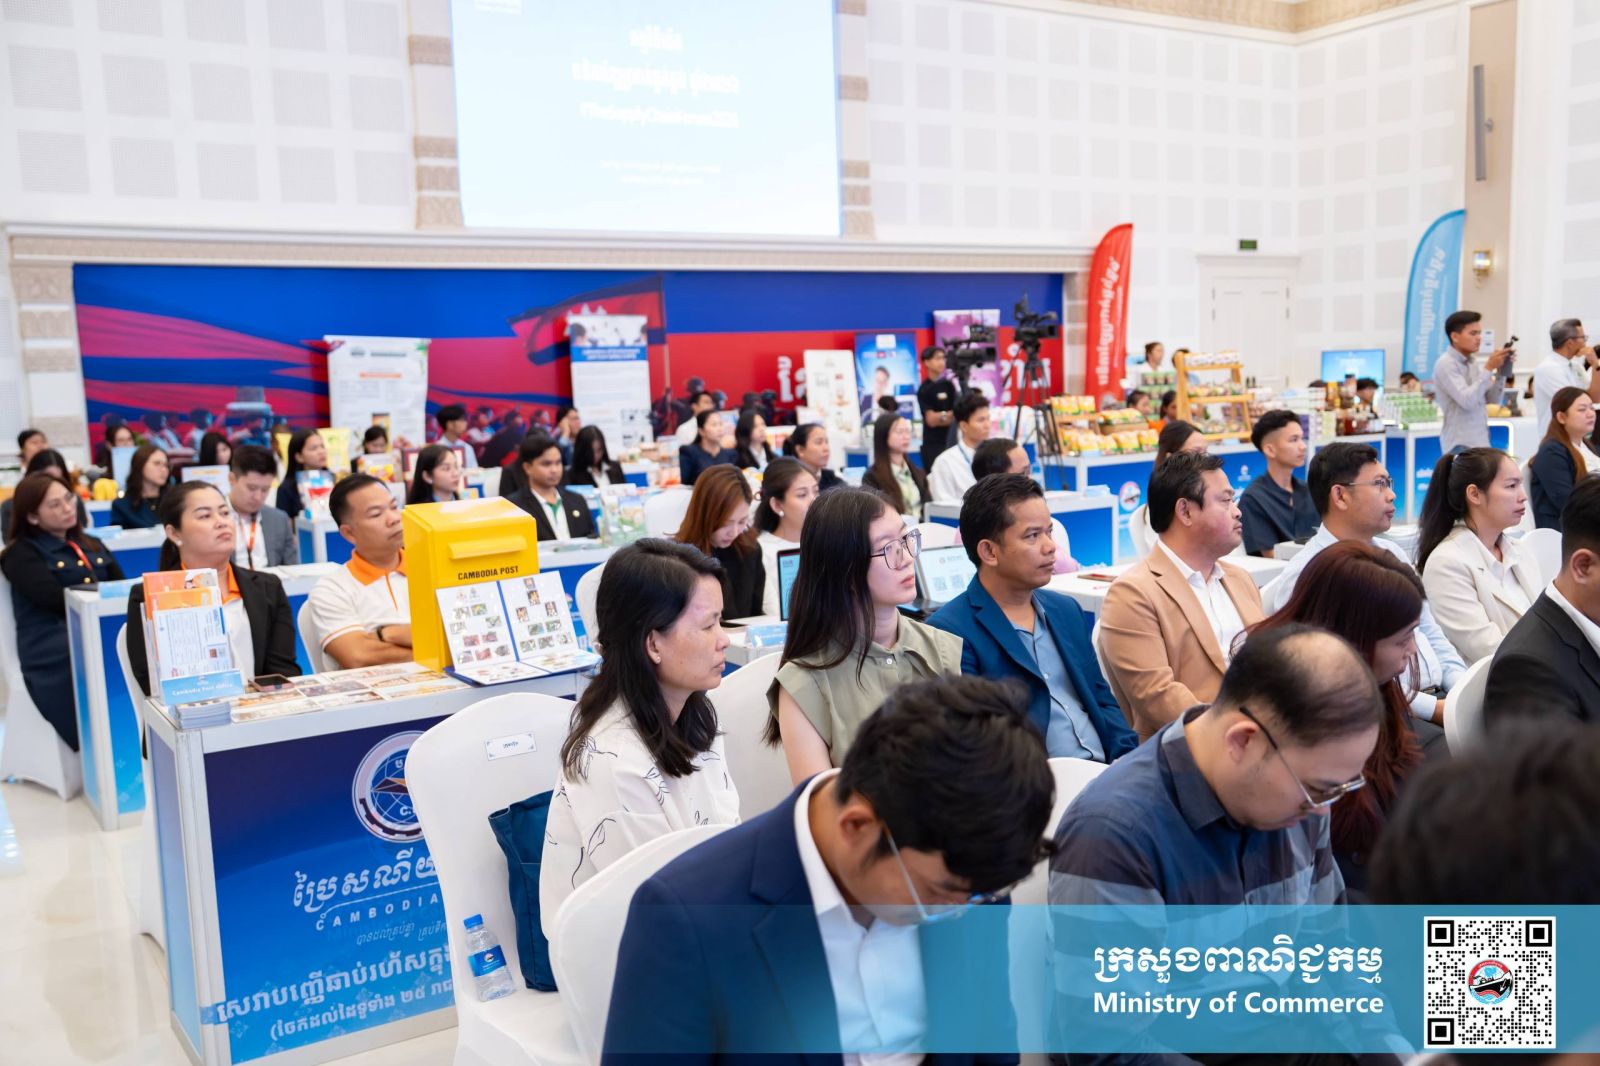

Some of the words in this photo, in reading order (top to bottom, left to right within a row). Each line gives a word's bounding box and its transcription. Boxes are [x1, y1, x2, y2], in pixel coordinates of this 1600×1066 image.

[458, 568, 498, 580] CAMBODIA
[500, 565, 518, 575] POST
[315, 893, 438, 931] CAMBODIA
